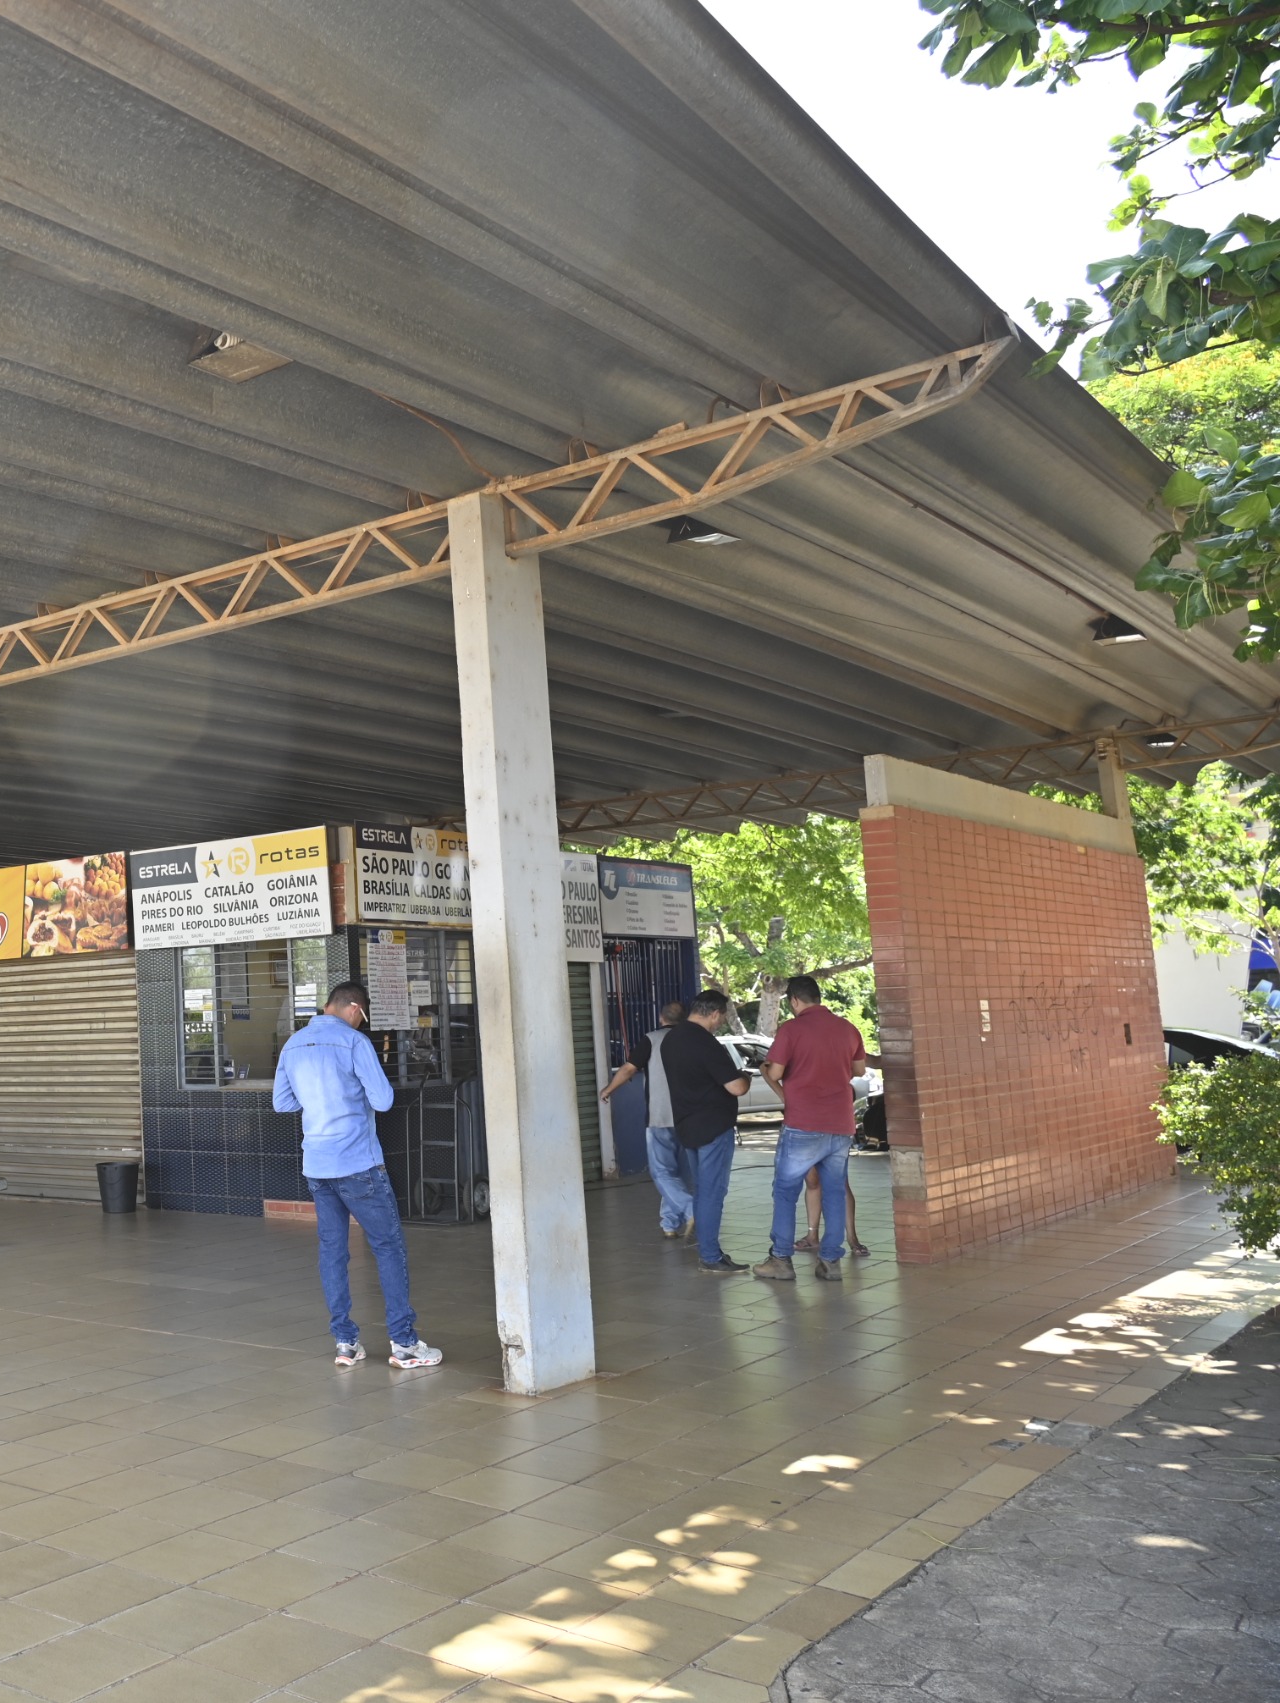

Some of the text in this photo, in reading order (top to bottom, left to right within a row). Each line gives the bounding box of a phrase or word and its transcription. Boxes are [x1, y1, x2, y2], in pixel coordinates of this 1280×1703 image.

[361, 828, 407, 845] ESTRELA
[139, 861, 192, 879] ESTRELA
[259, 845, 320, 864] rotas
[362, 853, 389, 874] SÃO
[140, 874, 318, 905] ANÁPOLIS CATALÃO GOIÂNIA
[363, 878, 410, 897] BRASÍLIA
[413, 884, 451, 900] CALDAS
[567, 880, 597, 901] PAULO
[141, 891, 319, 920] PIRES DO RIO SILVÂNIA ORIZONA
[363, 901, 407, 914] IMPERATRIZ
[410, 904, 441, 916] UBERABA
[142, 907, 320, 934] IPAMERI LEOPOLDO BULHÕES LUZIÂNIA
[565, 928, 600, 949] SANTOS
